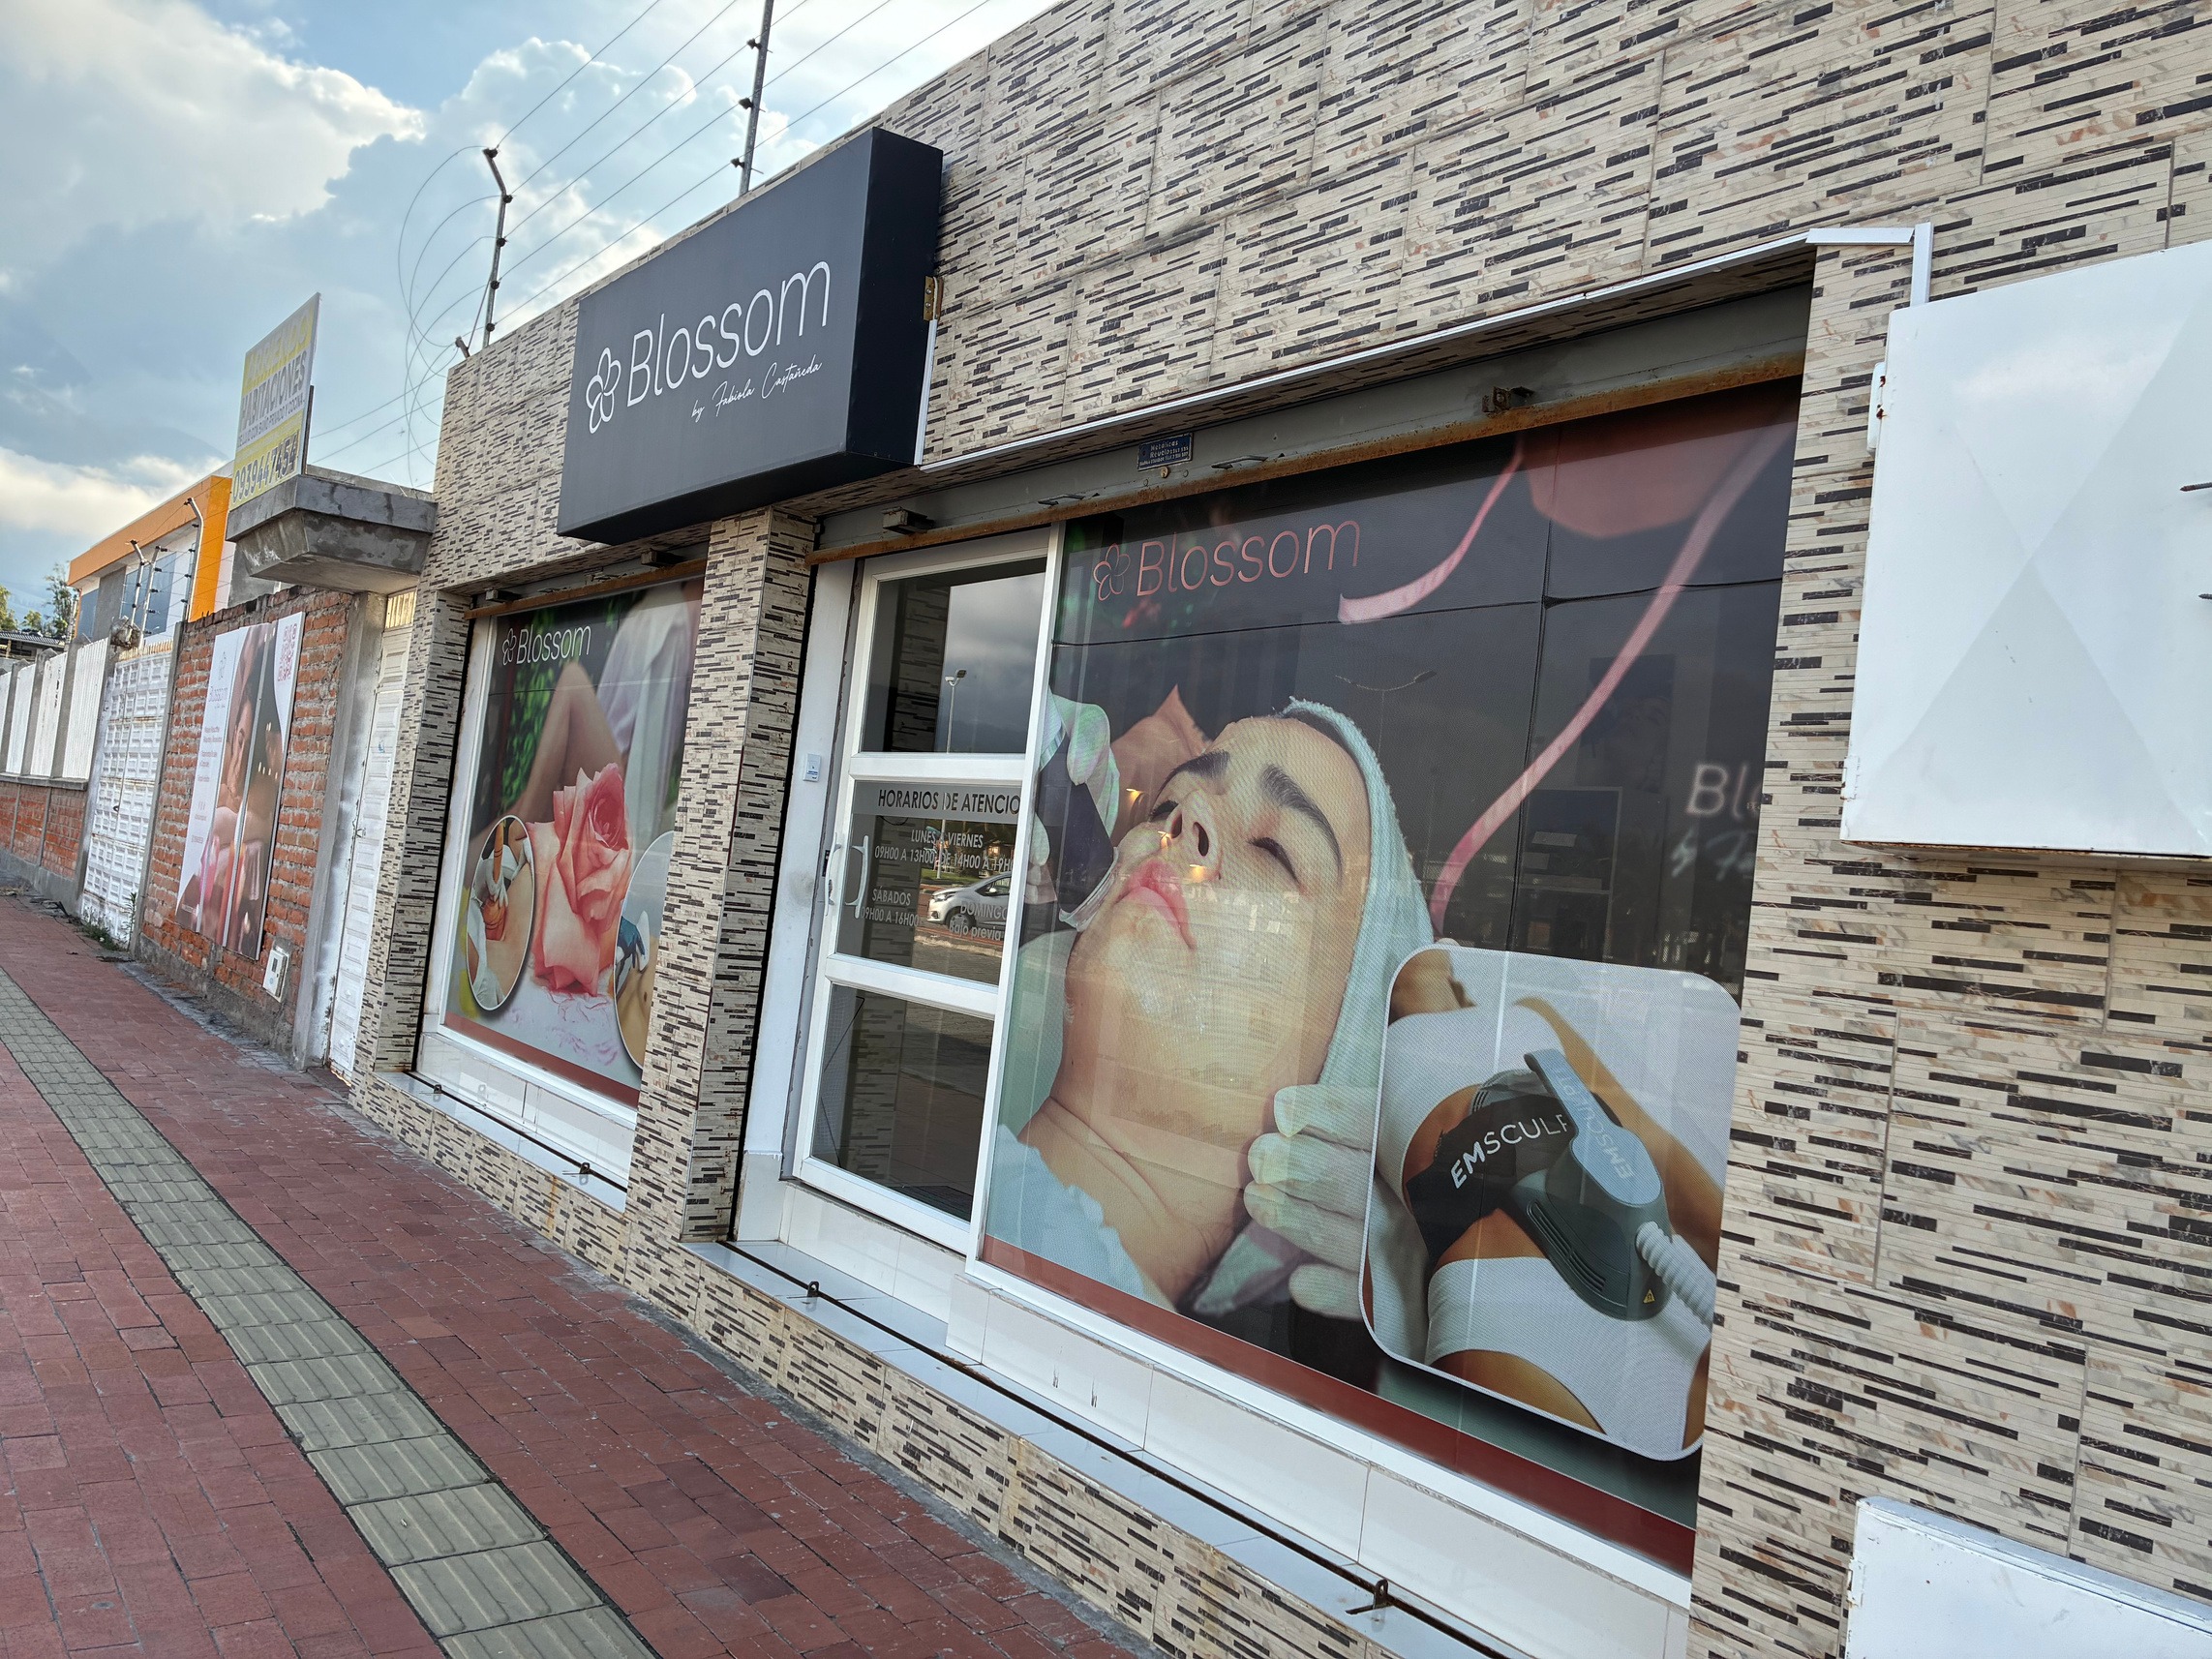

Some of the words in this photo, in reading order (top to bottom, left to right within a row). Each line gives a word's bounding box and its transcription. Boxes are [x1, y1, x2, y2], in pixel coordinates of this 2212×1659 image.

[247, 311, 310, 383] ARRIENDO
[626, 260, 832, 407] Blossom
[241, 349, 307, 431] HABITACIONES
[691, 400, 706, 423] by
[712, 378, 755, 417] Fabiola
[762, 353, 822, 399] Castañeda
[232, 430, 299, 503] 0939447454
[1136, 520, 1361, 596] Blossom
[517, 624, 591, 665] Blossom
[878, 789, 939, 810] HORARIOS
[943, 792, 958, 810] DE
[874, 845, 898, 860] 09H00
[900, 849, 907, 860] A
[910, 849, 935, 864] 13H00
[941, 852, 951, 864] DE
[954, 853, 980, 869] 14H00
[983, 856, 989, 869] A
[911, 830, 935, 844] LUNES
[948, 831, 984, 848] VIERNES
[861, 906, 883, 921] 09H00
[885, 910, 892, 923] A
[894, 911, 919, 927] 16H00
[872, 886, 911, 906] SÁBADOS
[950, 920, 968, 937] Bajo
[971, 925, 1001, 941] previa
